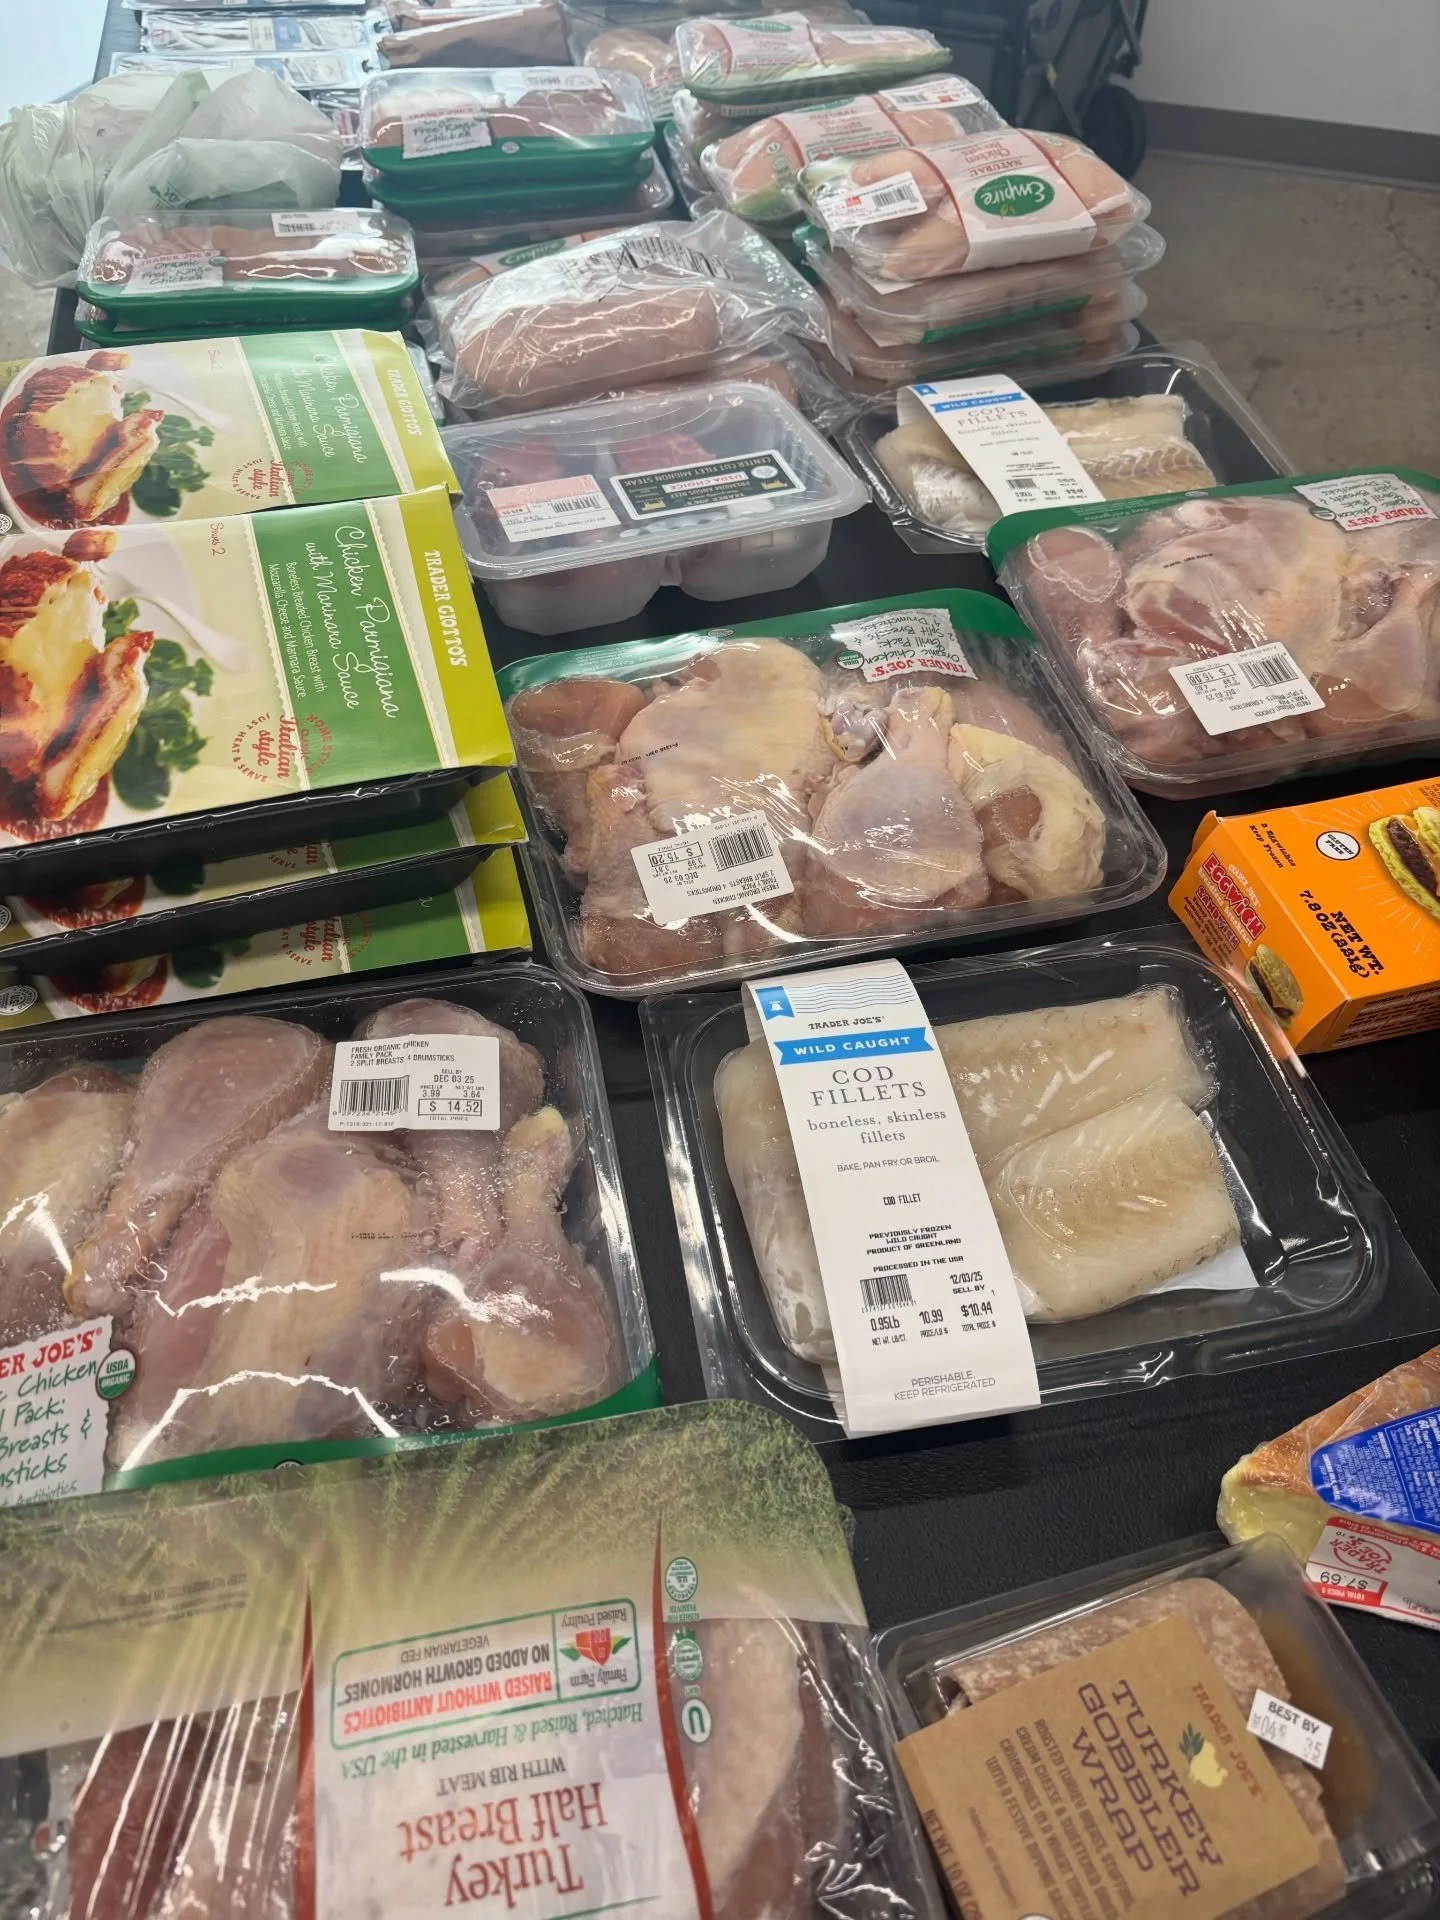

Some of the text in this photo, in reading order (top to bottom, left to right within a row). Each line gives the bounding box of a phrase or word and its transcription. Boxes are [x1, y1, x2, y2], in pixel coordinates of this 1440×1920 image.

[981, 180, 1046, 206] Empire
[957, 410, 1028, 426] FILLETS
[968, 406, 1006, 417] COD
[248, 468, 267, 490] style
[269, 459, 284, 497] Italian
[713, 473, 742, 484] USDA
[1381, 506, 1428, 520] TRADER
[424, 550, 468, 667] TRADER GIOTTO'S
[268, 563, 307, 698] Mozzarella Cheese and Marinara Sauce
[285, 562, 327, 693] Boneless Breaded Chicken Breast with
[305, 542, 360, 710] with Marinara Sauce
[334, 525, 400, 718] Chicken Parmigiana
[867, 626, 944, 641] Split Breasts
[917, 638, 941, 649] Grill
[865, 646, 960, 664] Organic Chicken
[875, 658, 967, 676] TRADER JOE'S
[232, 712, 270, 782] JUST HEAT SERVE
[252, 730, 276, 766] style
[277, 714, 299, 778] Italian
[1249, 825, 1283, 869] Keep Frozen
[1266, 830, 1296, 867] Eggwiches
[1325, 840, 1345, 856] FREE
[1327, 834, 1354, 855] GLUTEN
[651, 851, 679, 864] 15.20
[1299, 890, 1321, 912] 7.8
[1316, 914, 1336, 932] OZ
[1330, 910, 1384, 975] NET WT.
[808, 1016, 883, 1030] TRADER JOE'S
[350, 1052, 373, 1060] FAMILY
[351, 1040, 429, 1054] FRESH ORGANIC CHICKEN
[793, 1036, 911, 1056] WILD CAUGHT
[356, 1054, 455, 1067] SPLIT BREASTS DRUMSTICKS
[433, 1074, 475, 1084] DEC 03 25
[832, 1066, 894, 1085] COD
[422, 1090, 441, 1098] 3.99
[810, 1081, 927, 1107] FILLETS
[429, 1101, 480, 1114] $ 14.52
[807, 1108, 947, 1132] boneless, skinless
[860, 1130, 906, 1145] fillets
[837, 1155, 940, 1173] BAKE, PAN FRY OR BROIL
[898, 1193, 921, 1205] FILLET
[869, 1224, 952, 1240] PREVIOUSLY FROZEN
[886, 1232, 938, 1244] WILD CAUGHT
[866, 1238, 961, 1255] PRODUCT OF GREENLAND
[873, 1255, 964, 1273] PROCESSED IN THE USA
[950, 1271, 983, 1285] 12/03/25
[952, 1284, 986, 1294] SELL BY
[919, 1301, 993, 1325] 10.99 $10.44
[32, 1329, 97, 1368] JOE'S
[106, 1358, 129, 1373] USDA
[17, 1359, 97, 1398] Chicken
[100, 1374, 130, 1387] ORGANIC
[894, 1378, 996, 1401] KEEP REFRIGERATED
[911, 1370, 976, 1388] PERISHABLE,
[14, 1398, 66, 1427] Pack:
[80, 1408, 93, 1440] &
[1329, 1538, 1388, 1574] TRADER
[1320, 1571, 1368, 1590] $7.69
[561, 1608, 627, 1628] Raised Poultry
[401, 1634, 490, 1664] VEGETARIAN FED
[345, 1643, 550, 1700] NO ADDED GROWTH HORMONES
[569, 1667, 627, 1688] Family Farm
[344, 1671, 553, 1732] RAISED WITHOUT ANTIBIOTICS
[1268, 1701, 1320, 1735] BEST BY
[341, 1702, 642, 1778] Hatched, Raised & Harvested in the USA
[1034, 1718, 1065, 1766] ROASTED
[1191, 1682, 1263, 1797] TRADER JOE'S
[436, 1756, 566, 1796] WITH RIB MEAT
[1016, 1726, 1062, 1808] CREAM CHEESE
[1112, 1679, 1223, 1866] TURKEY
[1072, 1727, 1153, 1872] WRAP
[1078, 1682, 1200, 1897] GOBBLER
[398, 1781, 608, 1863] Half Breast
[444, 1844, 584, 1909] Turkey
